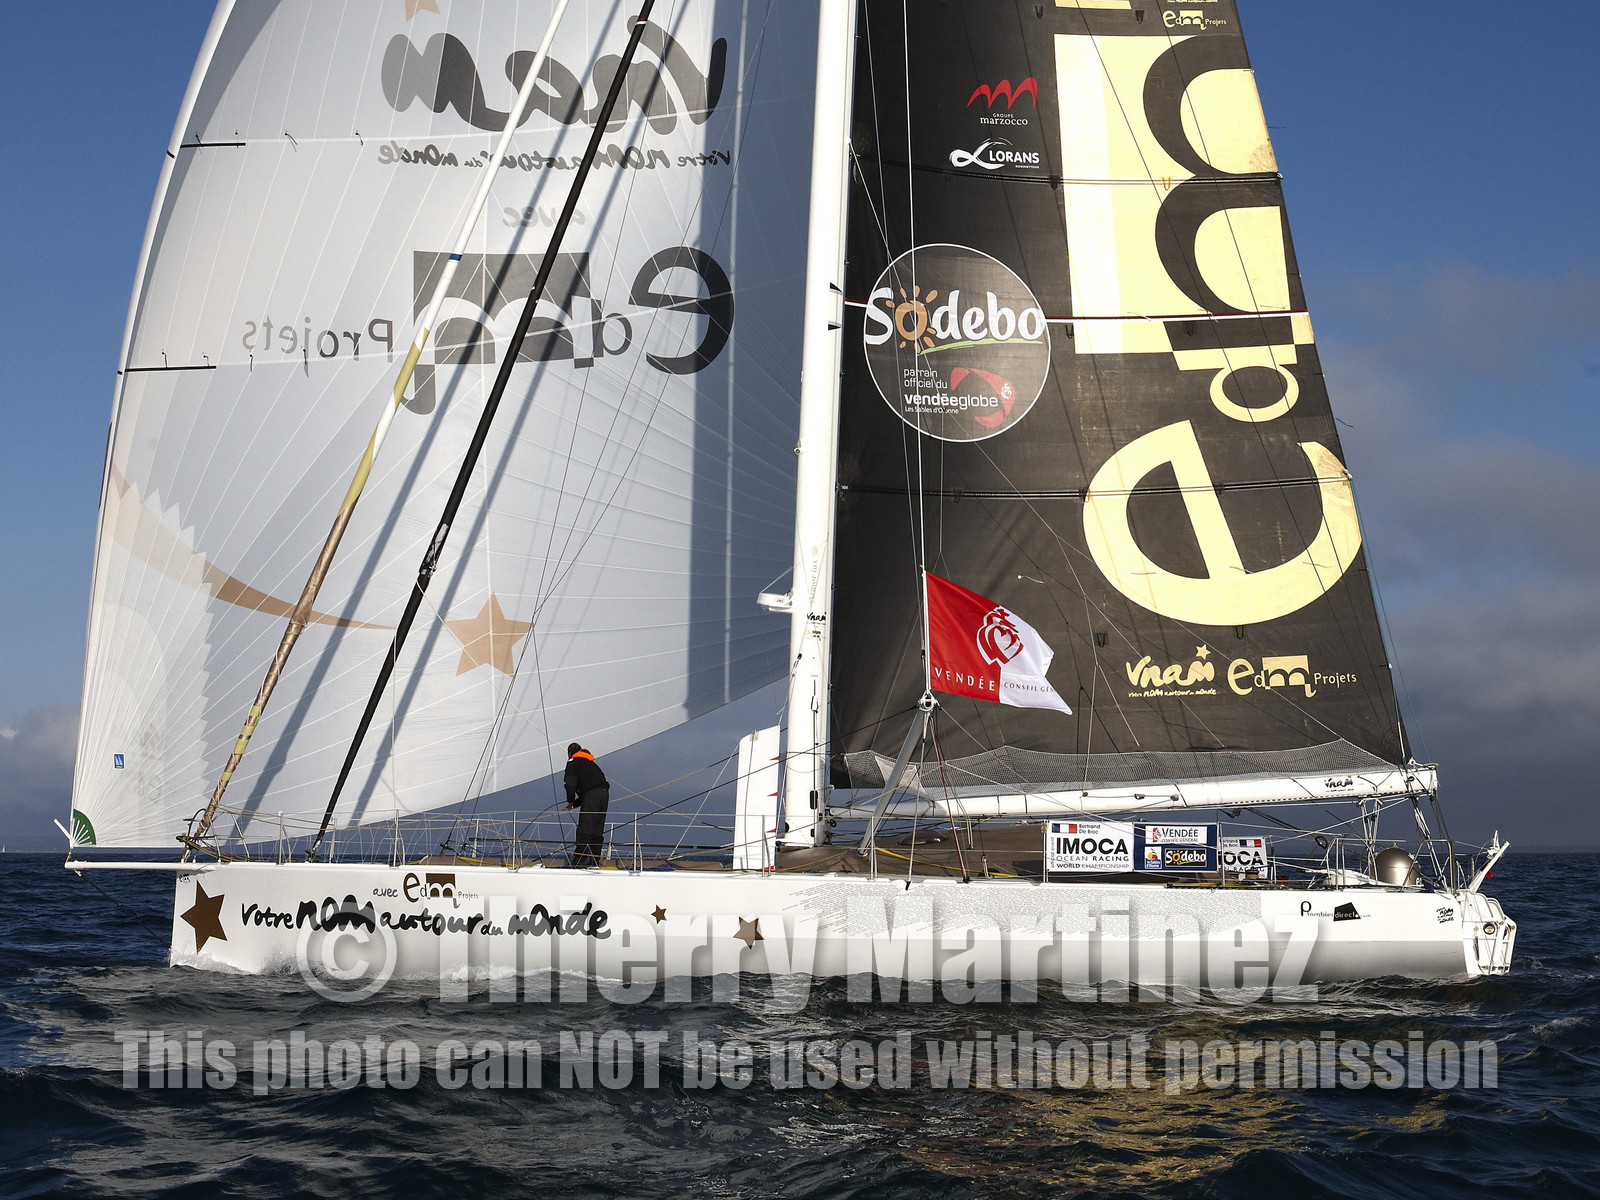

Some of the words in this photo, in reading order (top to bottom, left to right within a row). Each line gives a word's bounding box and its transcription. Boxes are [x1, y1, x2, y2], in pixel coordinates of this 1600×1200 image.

[1205, 18, 1227, 27] Projets
[980, 117, 1029, 126] marzocco
[989, 149, 1041, 165] LORANS
[864, 286, 1047, 346] Sodebo
[904, 378, 934, 389] offciel
[936, 379, 948, 390] du
[934, 667, 996, 692] VENDÉE
[1003, 682, 1038, 692] CONSEIL
[1314, 673, 1358, 689] Projets
[1161, 827, 1199, 838] VENDÉE
[1056, 837, 1129, 855] IMOCA
[1165, 848, 1207, 865] Sodebo
[372, 887, 399, 898] avec
[458, 891, 479, 901] Projets
